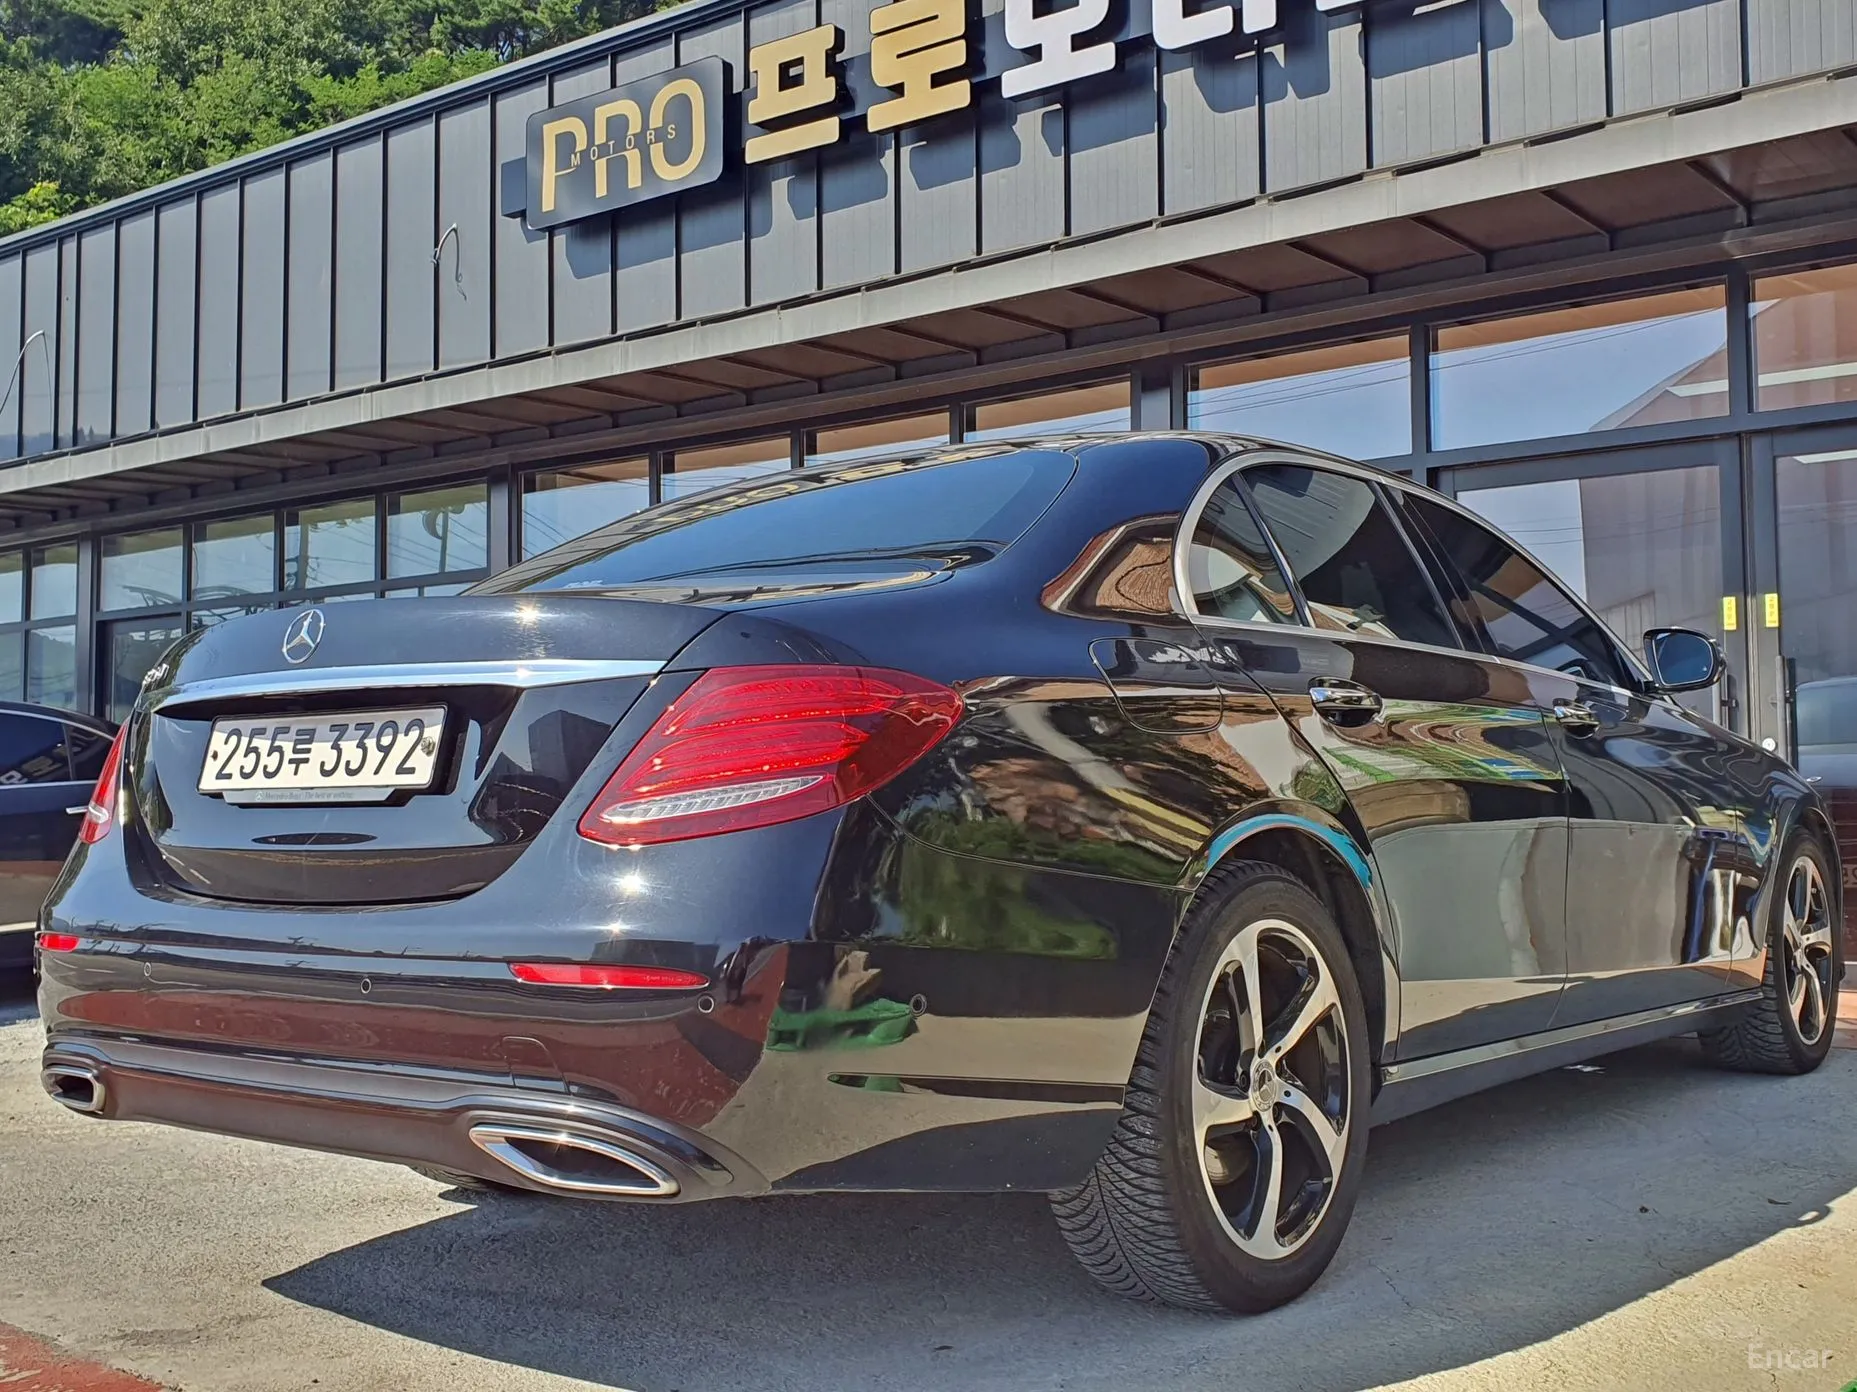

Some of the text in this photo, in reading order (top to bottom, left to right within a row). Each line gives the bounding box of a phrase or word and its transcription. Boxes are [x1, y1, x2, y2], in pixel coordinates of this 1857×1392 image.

[541, 78, 706, 213] PRO
[571, 124, 676, 167] MOTORS
[320, 718, 425, 777] 3392
